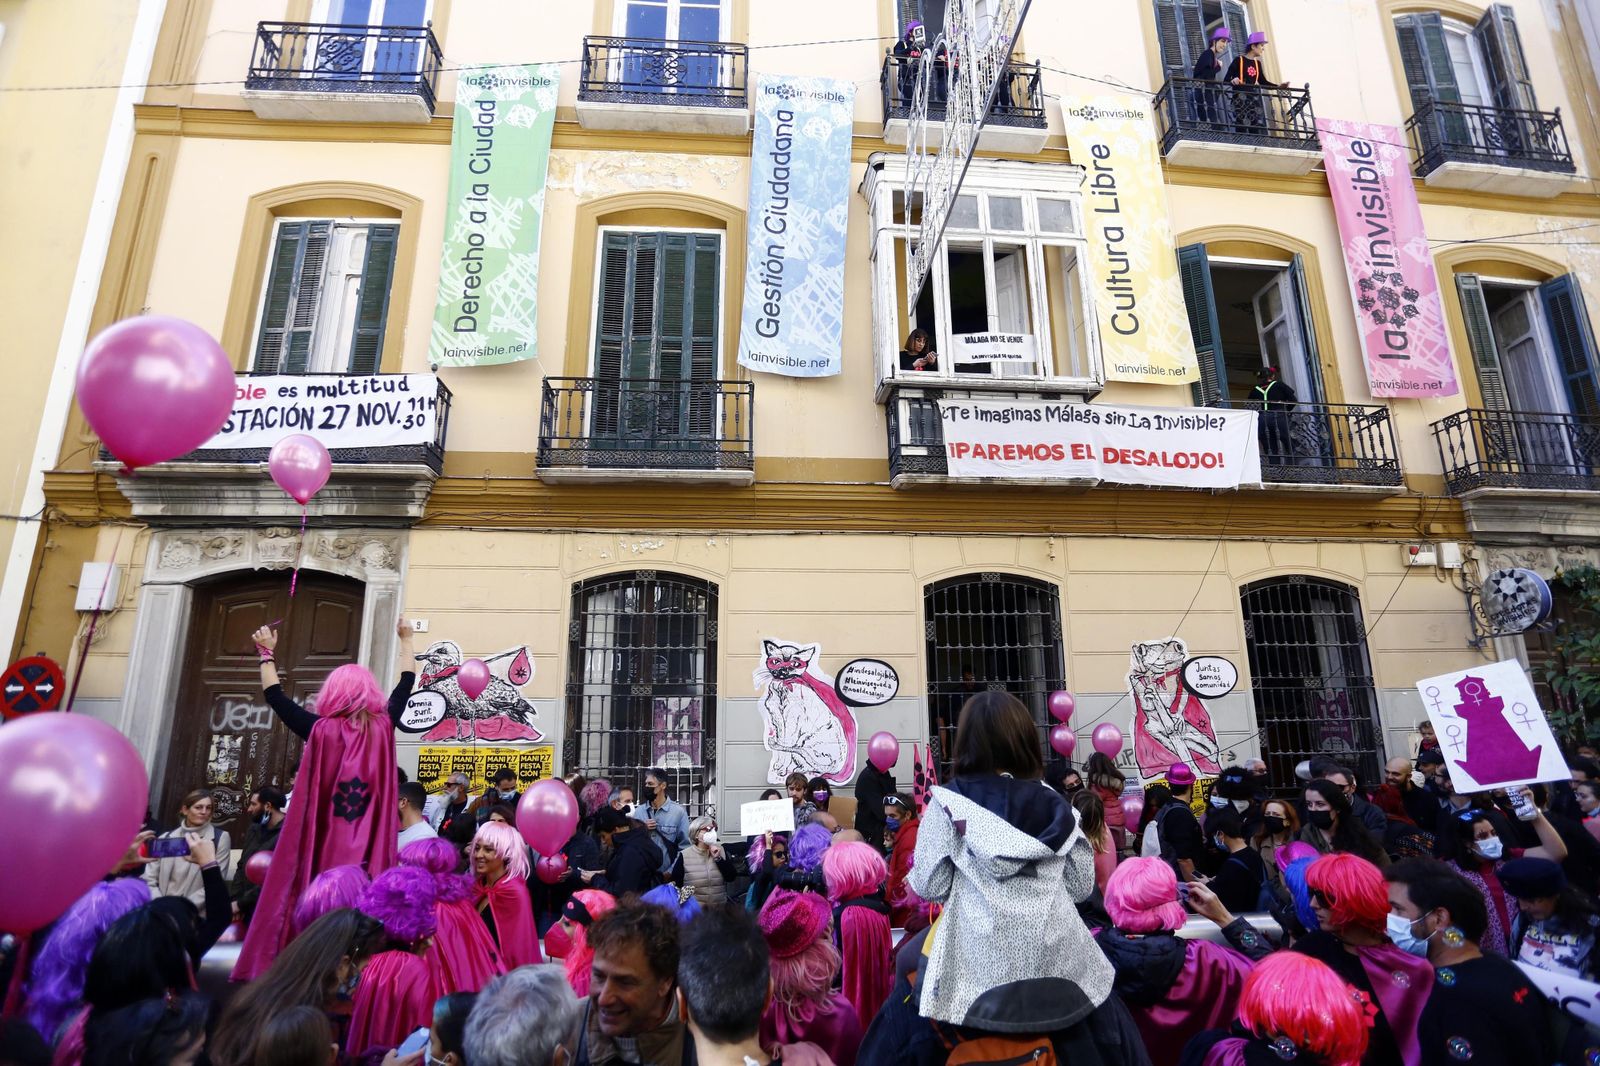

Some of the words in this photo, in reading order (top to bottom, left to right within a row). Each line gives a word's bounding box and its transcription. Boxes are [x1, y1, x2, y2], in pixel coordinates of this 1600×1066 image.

[466, 77, 479, 86] la
[500, 77, 551, 86] invisible
[764, 85, 776, 96] la
[796, 88, 845, 103] invisible
[1069, 108, 1080, 117] la
[1099, 109, 1144, 119] invisible
[469, 100, 496, 175] Ciudad
[764, 109, 794, 234] Ciudadana
[1091, 143, 1120, 214] Libre
[467, 183, 489, 202] la
[1347, 140, 1395, 268] invisible
[470, 211, 487, 223] a
[453, 233, 485, 333] Derecho
[1103, 226, 1140, 336] Cultura
[755, 245, 785, 338] Gestión
[964, 335, 989, 344] MÁLAGA
[990, 335, 998, 343] NO
[1378, 329, 1411, 360] la
[443, 342, 528, 358] lainvisible.net
[748, 350, 830, 368] lainvisible.net
[1115, 363, 1187, 377] lainvisible.net
[235, 384, 266, 400] ble
[278, 386, 298, 398] es
[307, 376, 410, 398] multitud
[1371, 379, 1443, 390] ainvisible.net
[220, 402, 314, 434] STACIÓN
[318, 404, 350, 430] 27
[356, 401, 401, 427] NOV.
[402, 414, 426, 430] 30
[942, 406, 970, 422] ¿Te
[974, 406, 1042, 424] imaginas
[1045, 404, 1100, 425] Málaga
[1104, 411, 1126, 426] sin
[1128, 413, 1151, 430] La
[1153, 414, 1226, 431] Invisible?
[948, 442, 1065, 461] ¡PAREMOS
[1071, 443, 1096, 461] EL
[1102, 447, 1225, 469] DESALOJO!
[1195, 661, 1220, 673] Juntas
[1195, 681, 1230, 689] comunidad
[408, 699, 432, 709] Omnia
[414, 707, 432, 717] sunt
[407, 715, 437, 726] comunia
[520, 769, 538, 777] CIÓN
